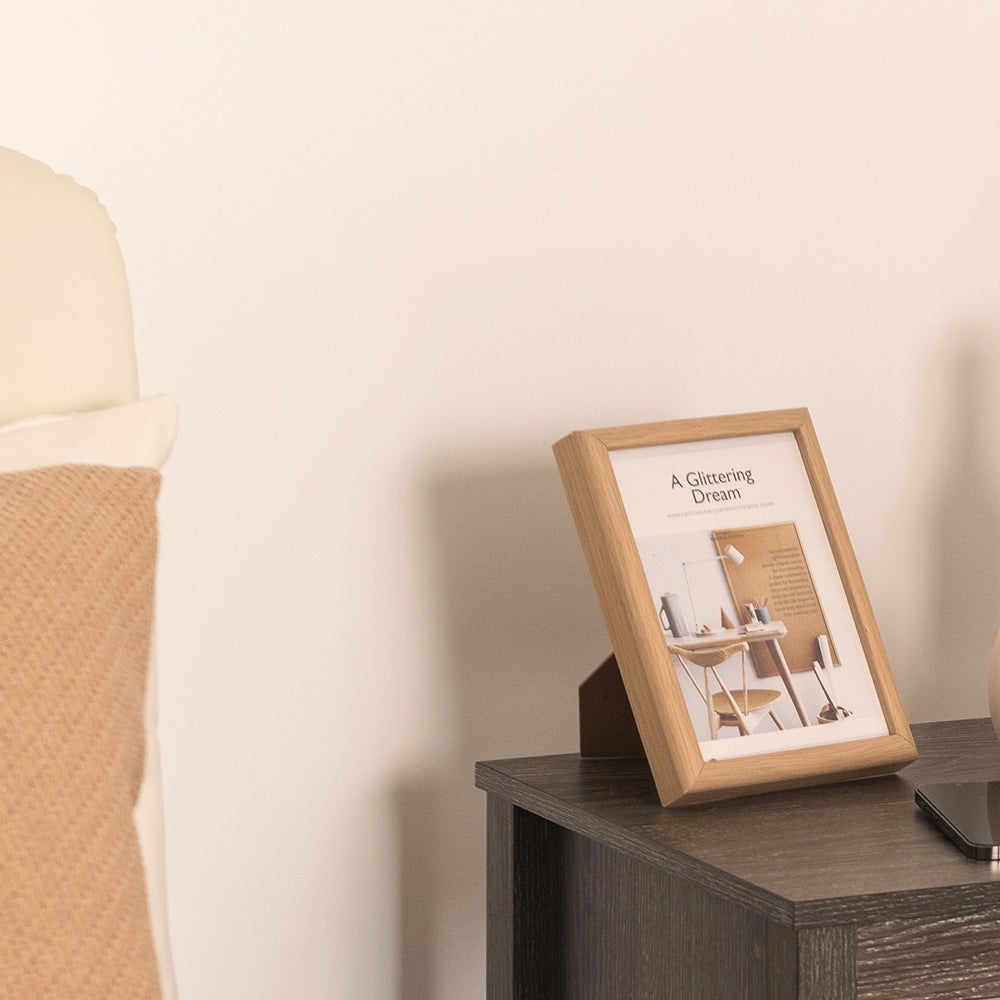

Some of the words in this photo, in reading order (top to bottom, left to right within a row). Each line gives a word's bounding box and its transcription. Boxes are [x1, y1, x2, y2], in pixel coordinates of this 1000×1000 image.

[671, 473, 684, 489] A
[686, 468, 755, 487] Glittering
[691, 488, 742, 504] Dream
